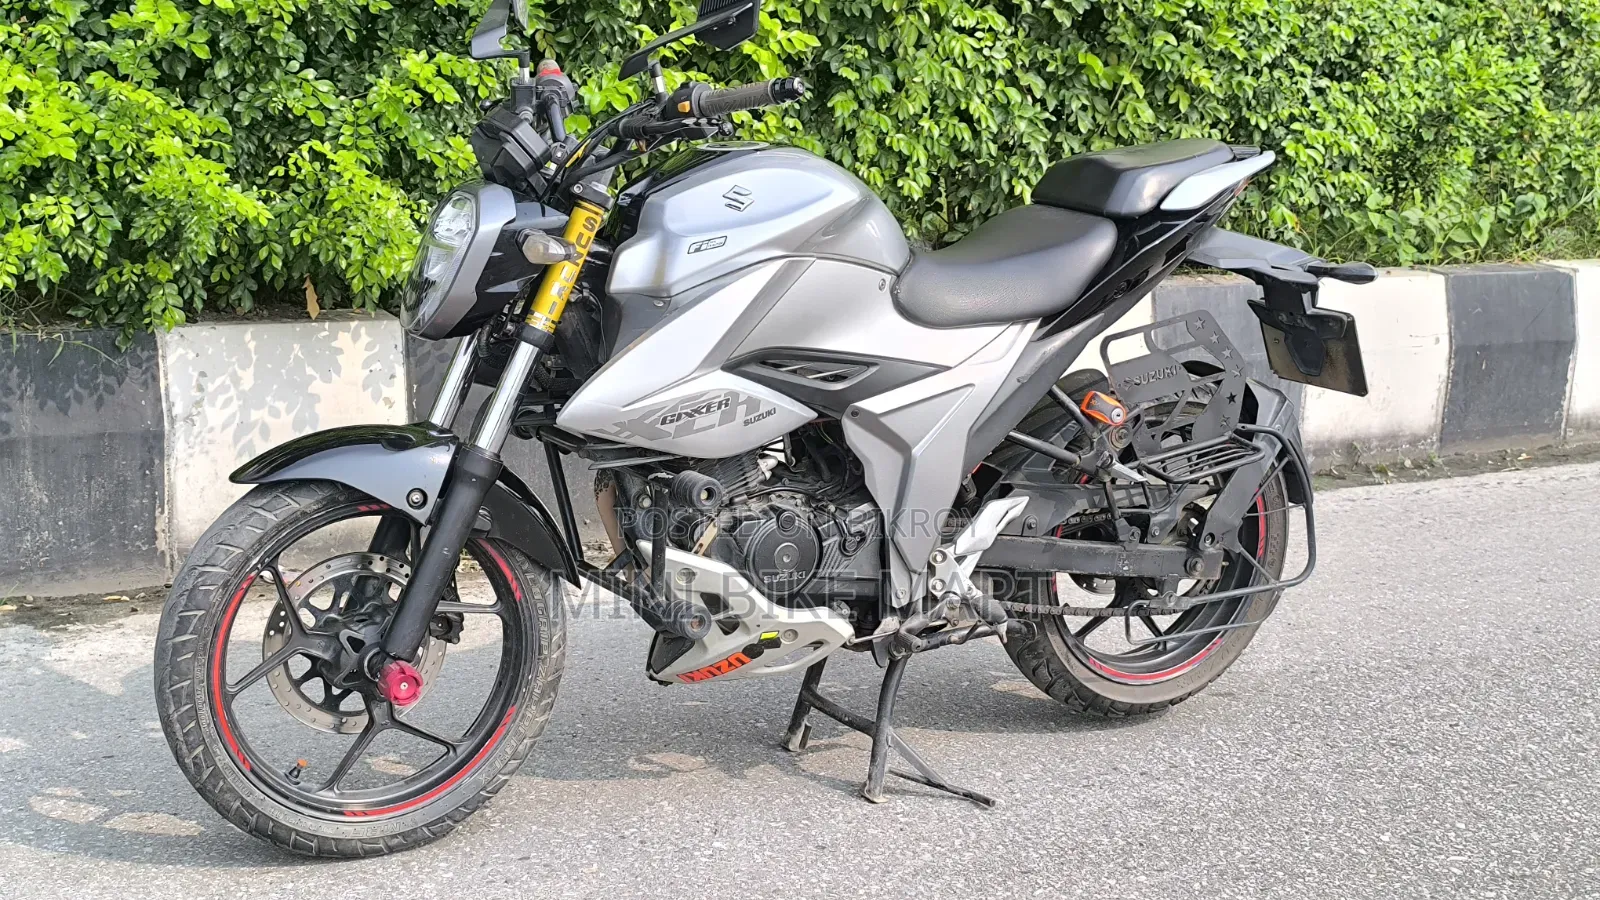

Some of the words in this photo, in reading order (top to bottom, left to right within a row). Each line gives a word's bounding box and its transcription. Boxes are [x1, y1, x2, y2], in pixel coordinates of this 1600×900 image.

[549, 216, 598, 315] SUZUKI
[1133, 365, 1177, 386] SUZUKI
[660, 397, 730, 426] GIXXER
[743, 407, 776, 427] SUZUKI
[763, 570, 806, 583] SUZUKI
[677, 651, 752, 684] UZUKI
